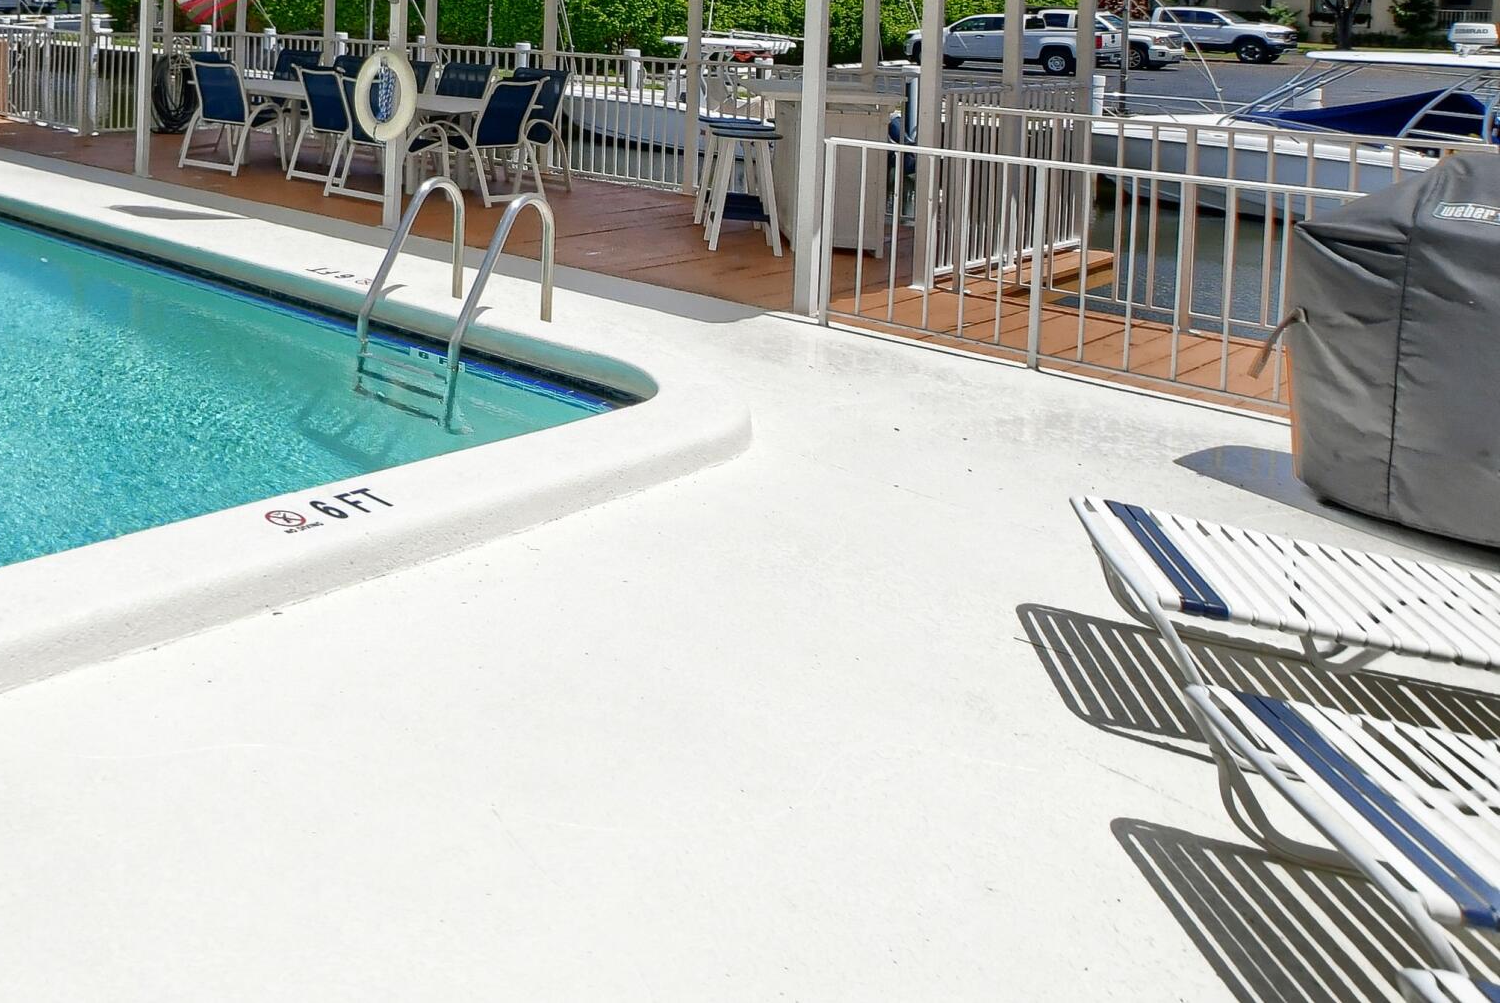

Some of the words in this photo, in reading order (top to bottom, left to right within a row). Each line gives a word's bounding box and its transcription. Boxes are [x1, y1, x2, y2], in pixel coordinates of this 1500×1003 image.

[1440, 204, 1496, 220] weber
[309, 500, 349, 519] 6
[333, 487, 394, 514] FT
